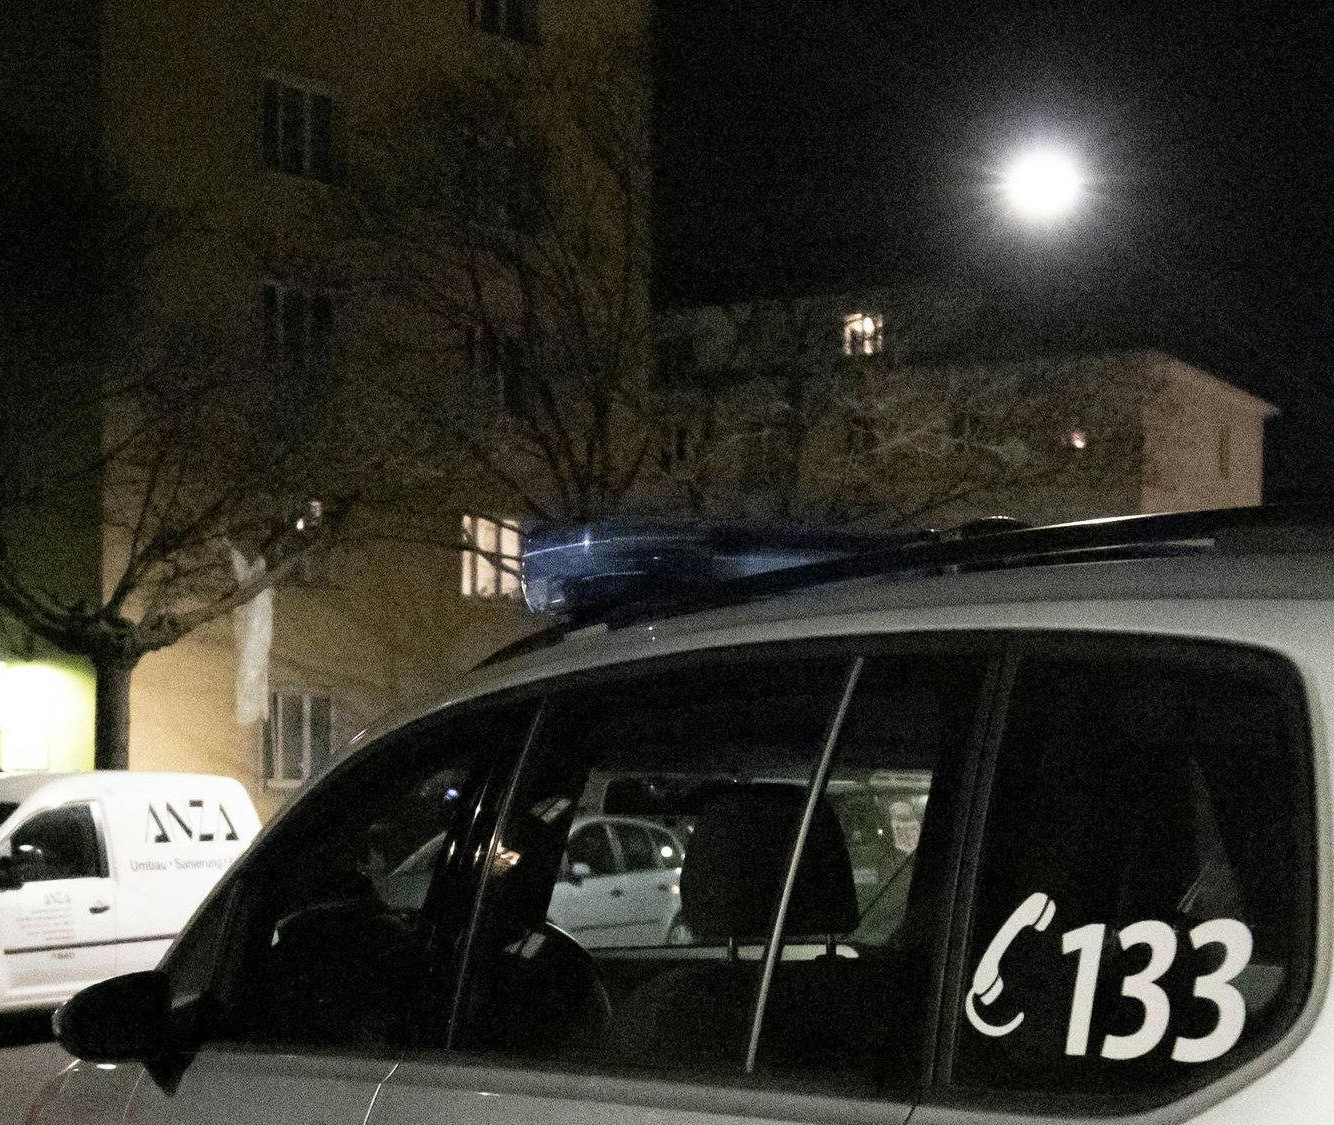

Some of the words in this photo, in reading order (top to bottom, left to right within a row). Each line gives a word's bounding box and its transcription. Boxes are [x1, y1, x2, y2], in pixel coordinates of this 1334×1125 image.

[145, 799, 240, 844] ANZA
[130, 859, 167, 872] Umbau
[174, 857, 223, 870] Sanierung
[1062, 918, 1254, 1063] 133
